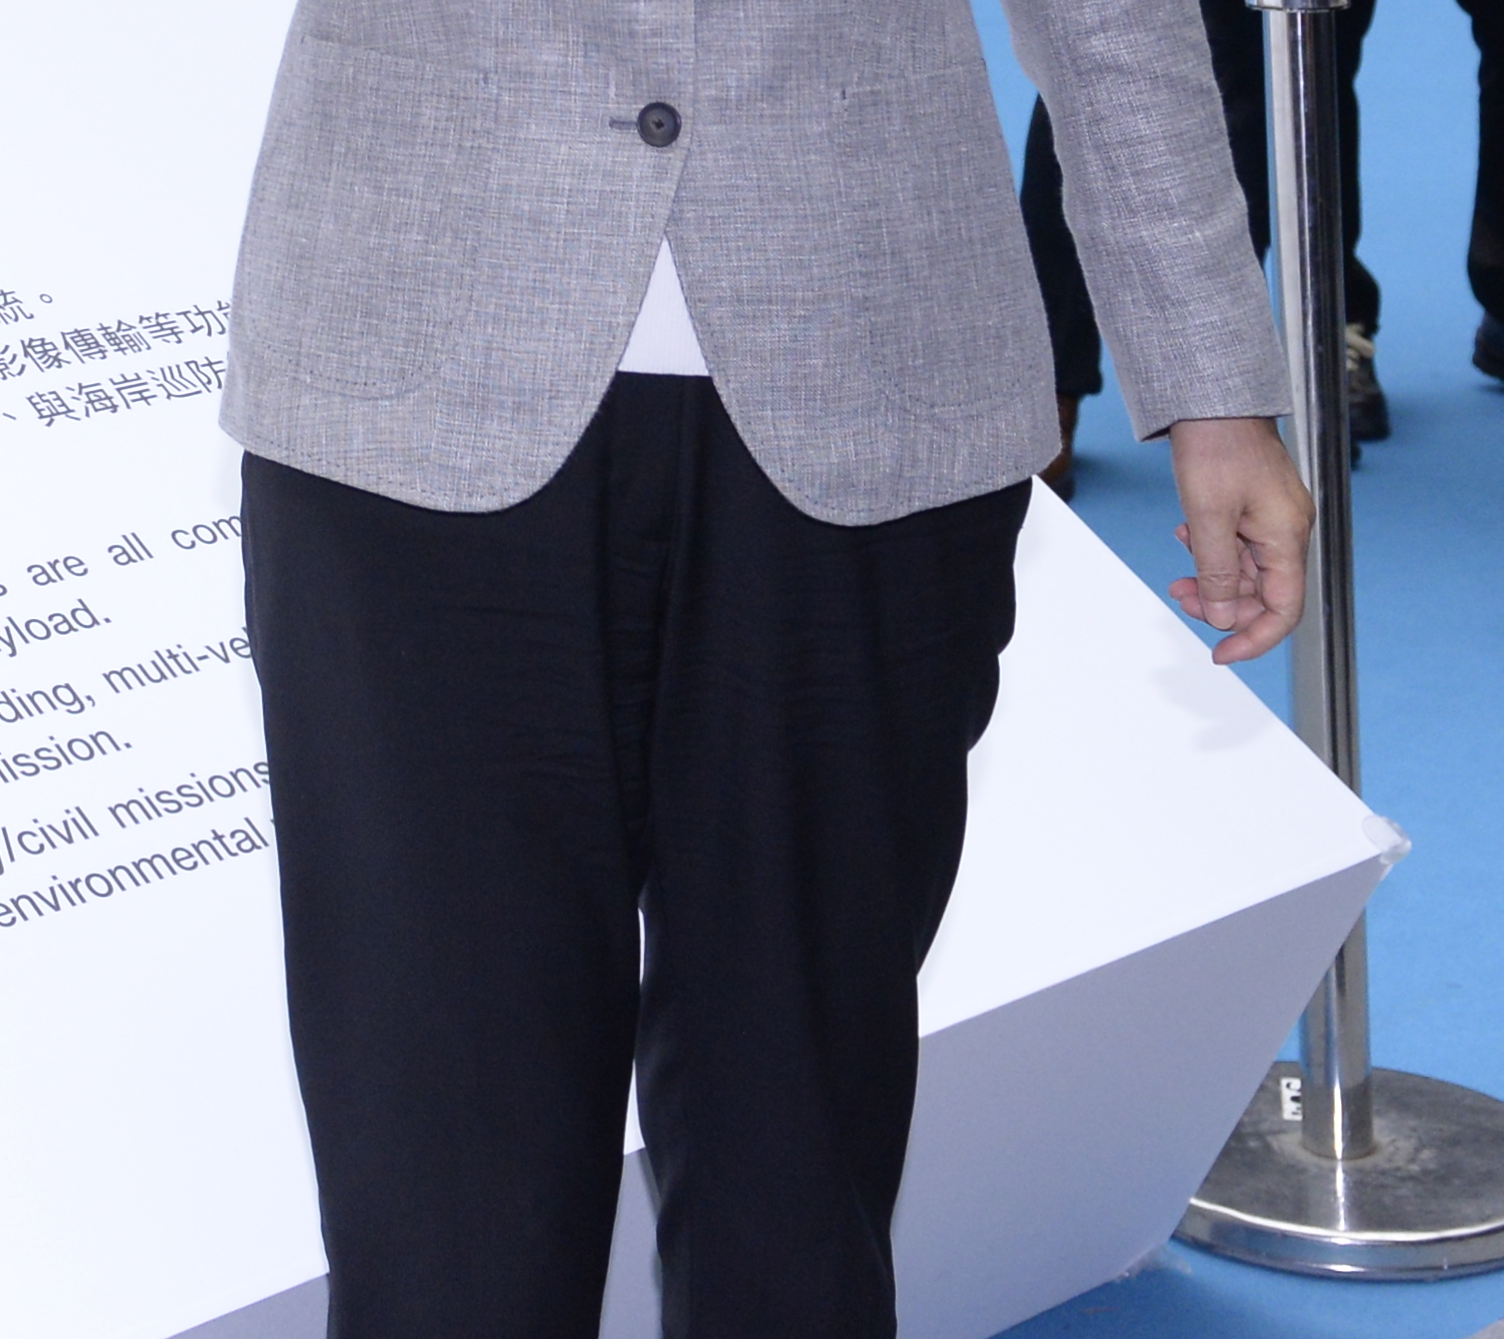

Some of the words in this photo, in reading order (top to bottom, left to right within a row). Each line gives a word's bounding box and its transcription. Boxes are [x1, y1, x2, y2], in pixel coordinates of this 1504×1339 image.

[26, 554, 89, 587] are
[107, 531, 154, 567] all
[102, 627, 253, 694] multi-ve
[107, 759, 271, 829] missions
